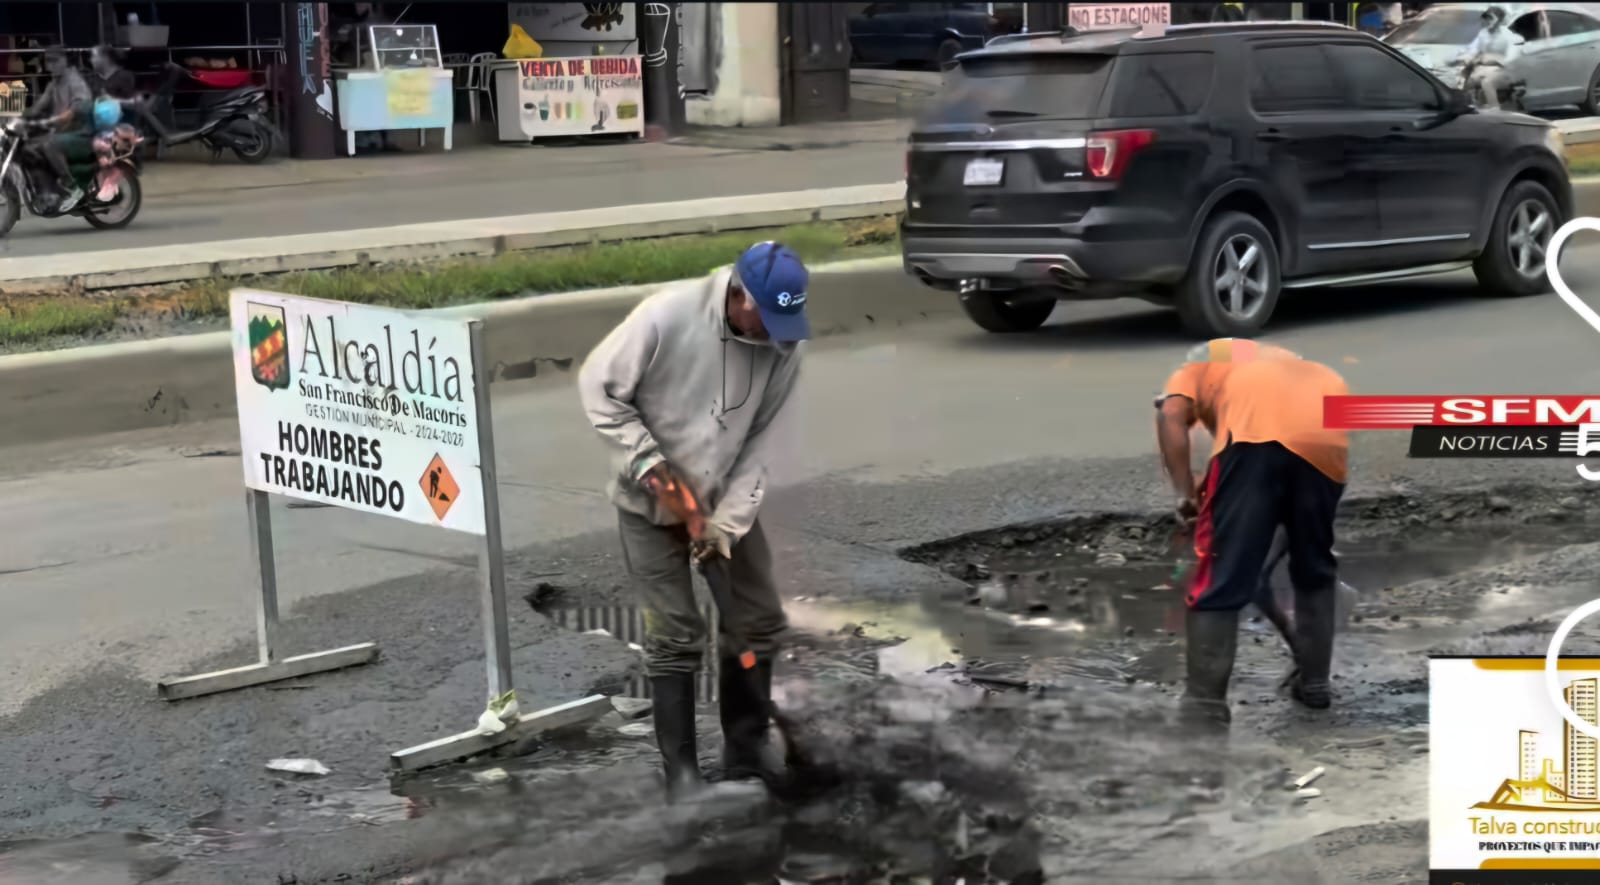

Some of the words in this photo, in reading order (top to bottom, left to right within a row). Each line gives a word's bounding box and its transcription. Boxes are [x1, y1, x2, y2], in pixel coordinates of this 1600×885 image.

[1071, 9, 1090, 28] NO
[1095, 6, 1168, 25] ESTACIONE
[520, 61, 564, 77] VENTA
[568, 60, 584, 76] DE
[590, 58, 638, 75] BEBIDA
[299, 313, 464, 402] Alcaldía
[299, 379, 322, 400] San
[326, 383, 388, 412] Francisco
[389, 394, 409, 416] De
[351, 411, 406, 435] MUNICIPAL
[278, 420, 382, 471] HOMBRES
[261, 453, 404, 512] TRABAJANDO
